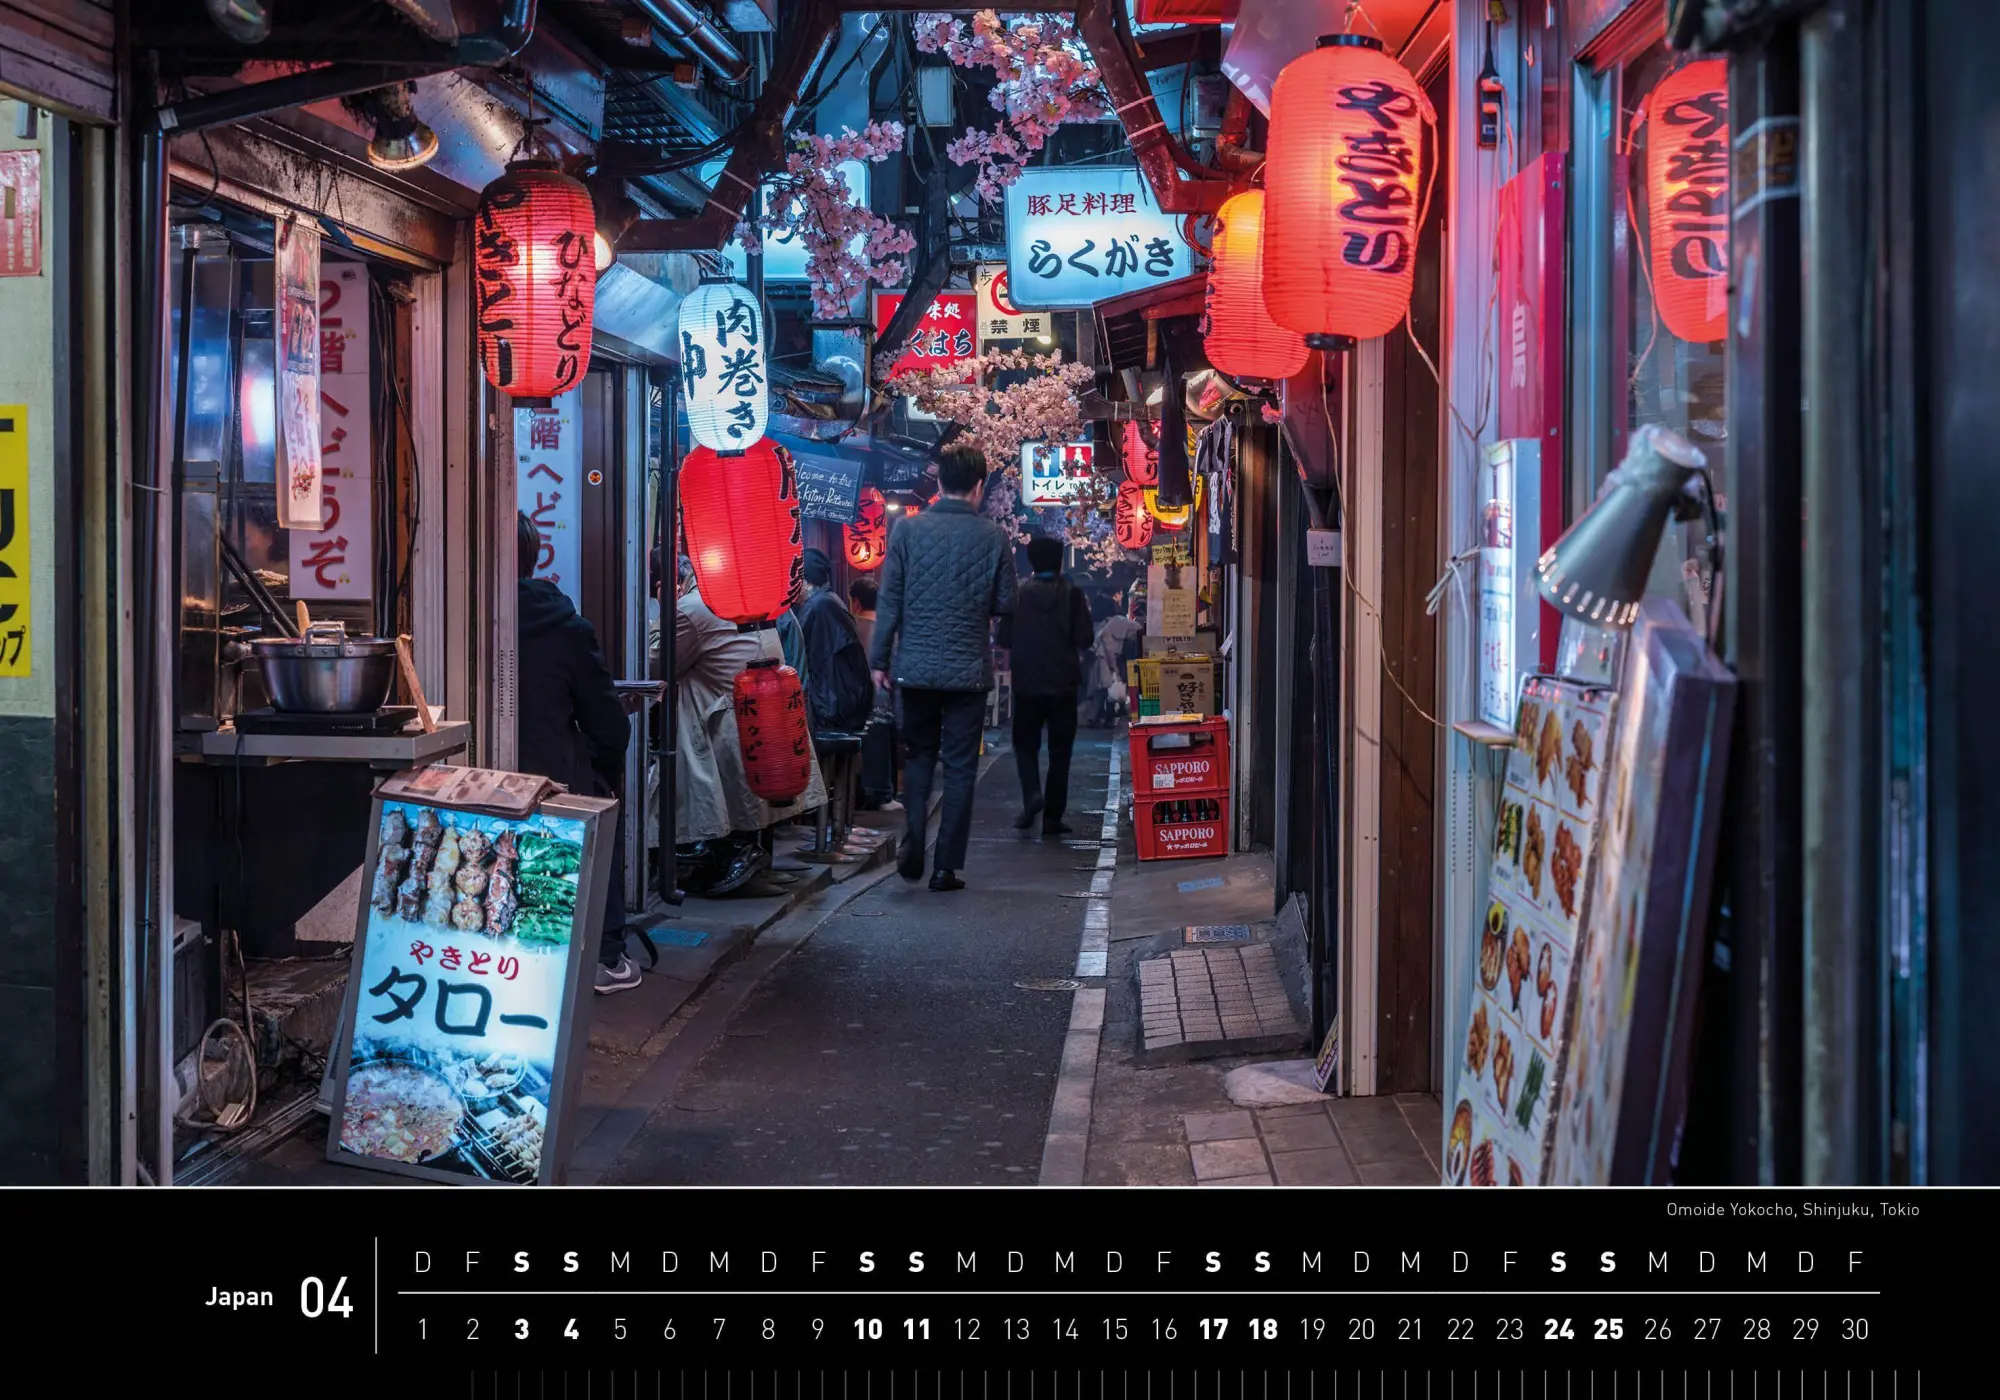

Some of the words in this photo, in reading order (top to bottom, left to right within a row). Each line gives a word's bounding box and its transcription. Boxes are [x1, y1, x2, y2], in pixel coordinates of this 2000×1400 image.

[1027, 192, 1137, 216] 豚足料理
[1028, 234, 1174, 279] らくがき
[716, 299, 764, 438] 肉巻き
[829, 473, 837, 484] to
[1032, 480, 1064, 491] トイレ
[1156, 760, 1210, 776] SAPPORO
[1160, 827, 1214, 842] SAPPORO
[409, 939, 520, 981] やきとり
[369, 966, 549, 1037] タロー
